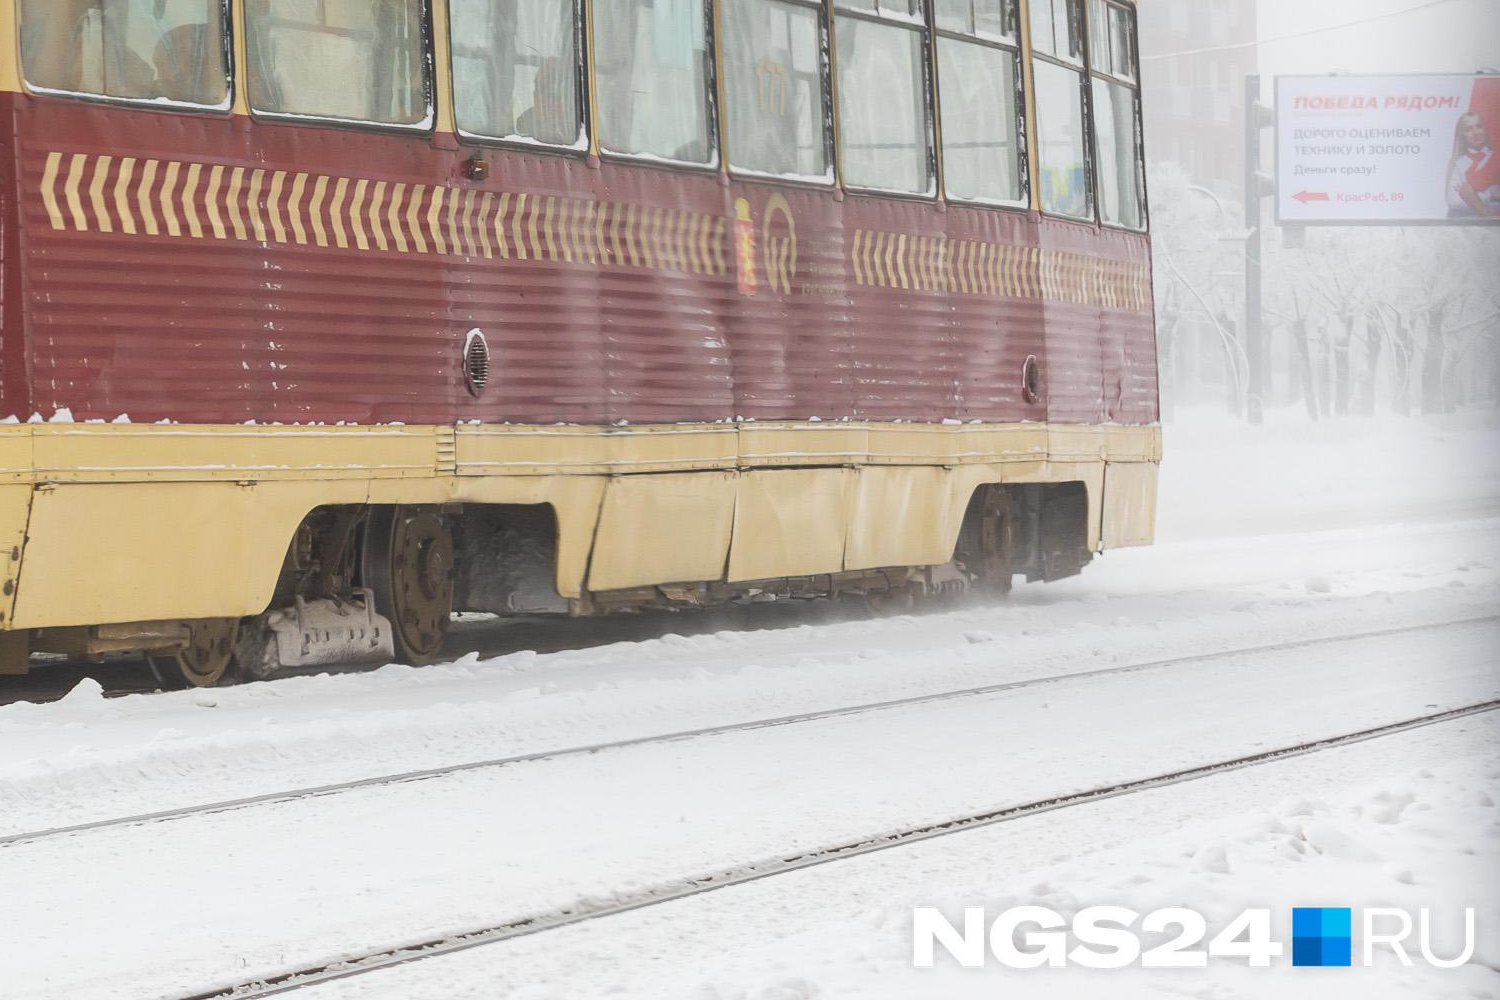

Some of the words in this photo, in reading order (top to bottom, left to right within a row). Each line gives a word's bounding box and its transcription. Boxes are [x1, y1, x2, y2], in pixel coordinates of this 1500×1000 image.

[1294, 96, 1378, 110] ПОБЕДА
[1384, 95, 1461, 111] РЯДОМ!
[1293, 128, 1346, 140] ДОРОГО
[1349, 128, 1431, 140] ОЦЕНИВАЕМ
[1294, 145, 1353, 156] ТЕХНИКУ
[1356, 146, 1365, 155] И
[1369, 145, 1420, 156] ЗОЛОТО
[1293, 164, 1337, 176] Деньги
[1340, 164, 1376, 177] сразу!
[1390, 192, 1404, 201] 89
